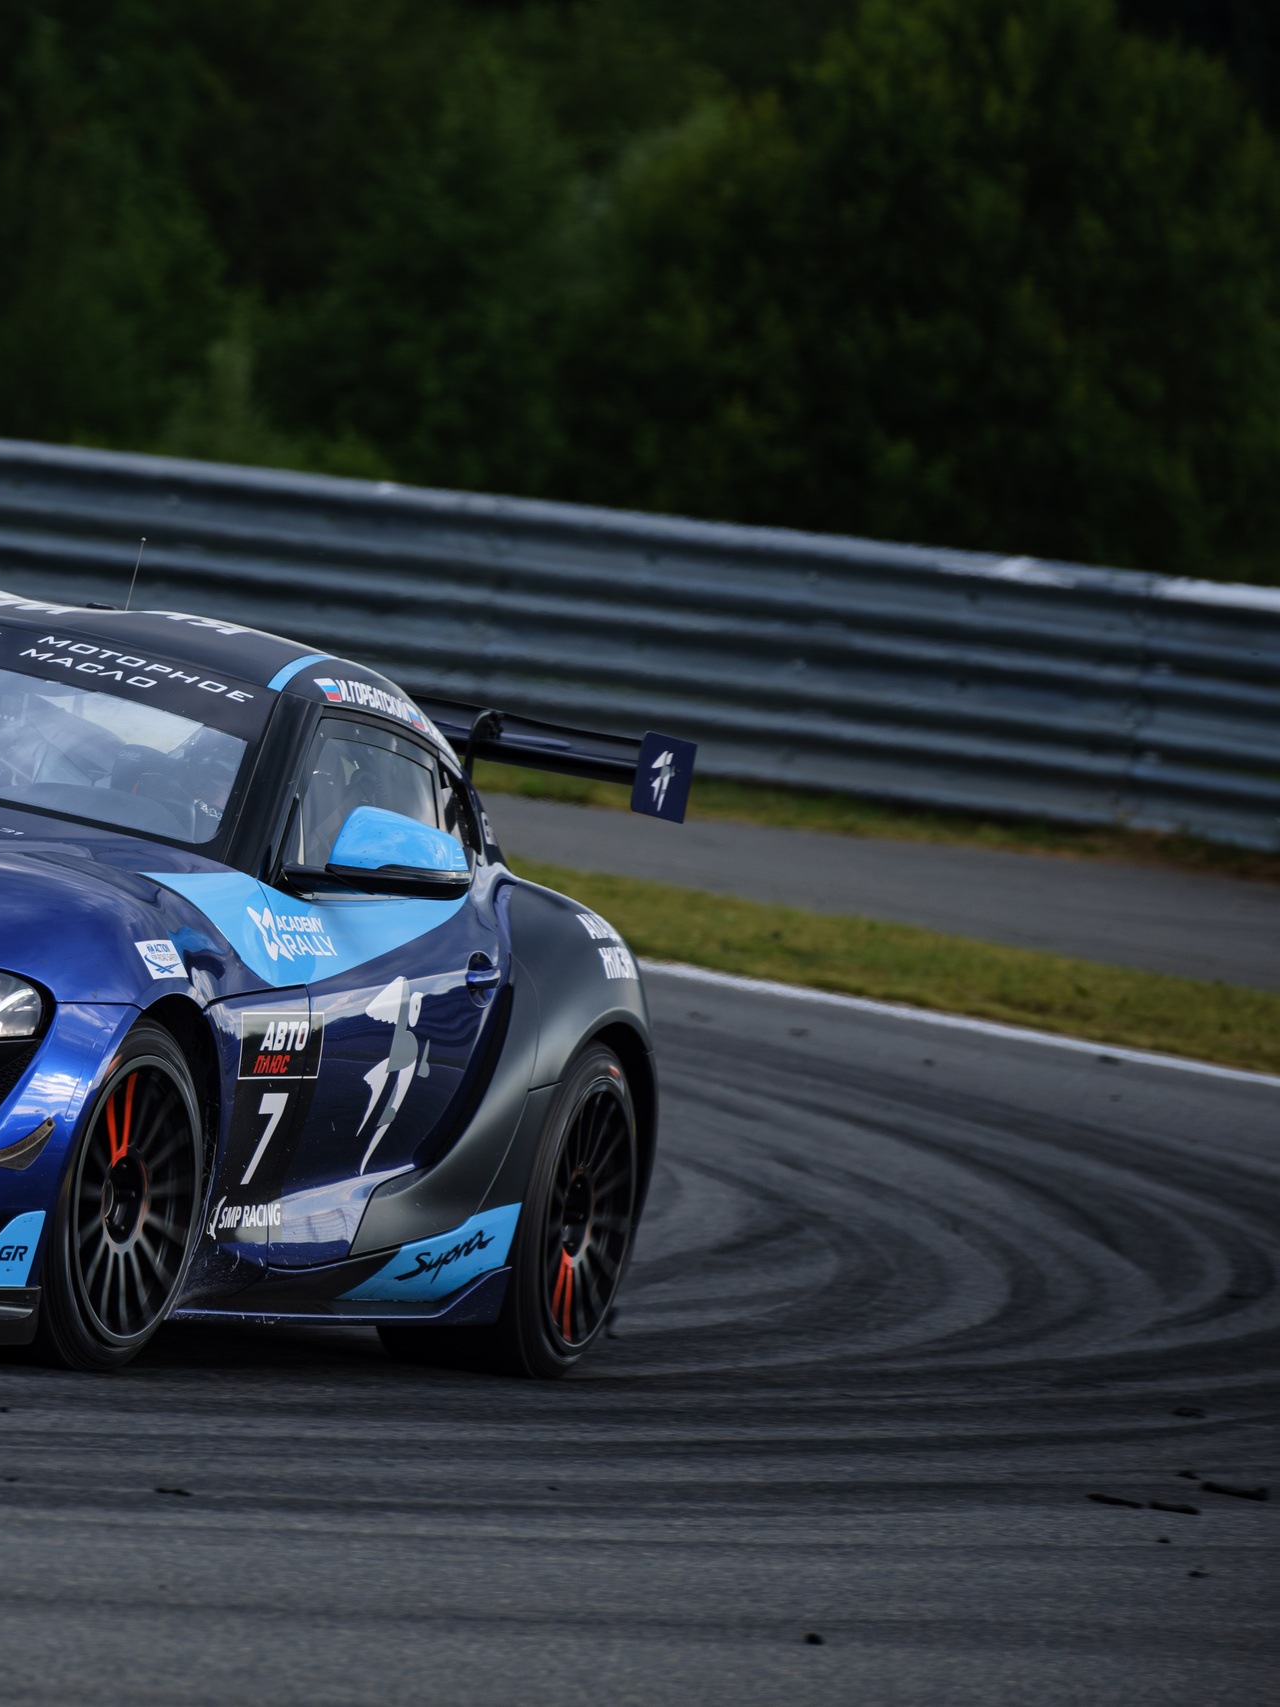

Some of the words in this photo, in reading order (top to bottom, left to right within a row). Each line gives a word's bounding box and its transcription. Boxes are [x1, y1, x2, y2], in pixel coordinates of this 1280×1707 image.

[19, 648, 158, 689] МАСЛО
[37, 636, 255, 703] МОТОРНОЕ
[275, 915, 324, 933] ACADEMY
[282, 934, 338, 956] RALLY
[260, 1021, 310, 1051] АВТО
[253, 1055, 291, 1074] ПЛЮС
[240, 1092, 289, 1185] 7
[218, 1206, 242, 1229] SMP
[241, 1203, 281, 1228] RACING
[394, 1230, 496, 1284] Supra
